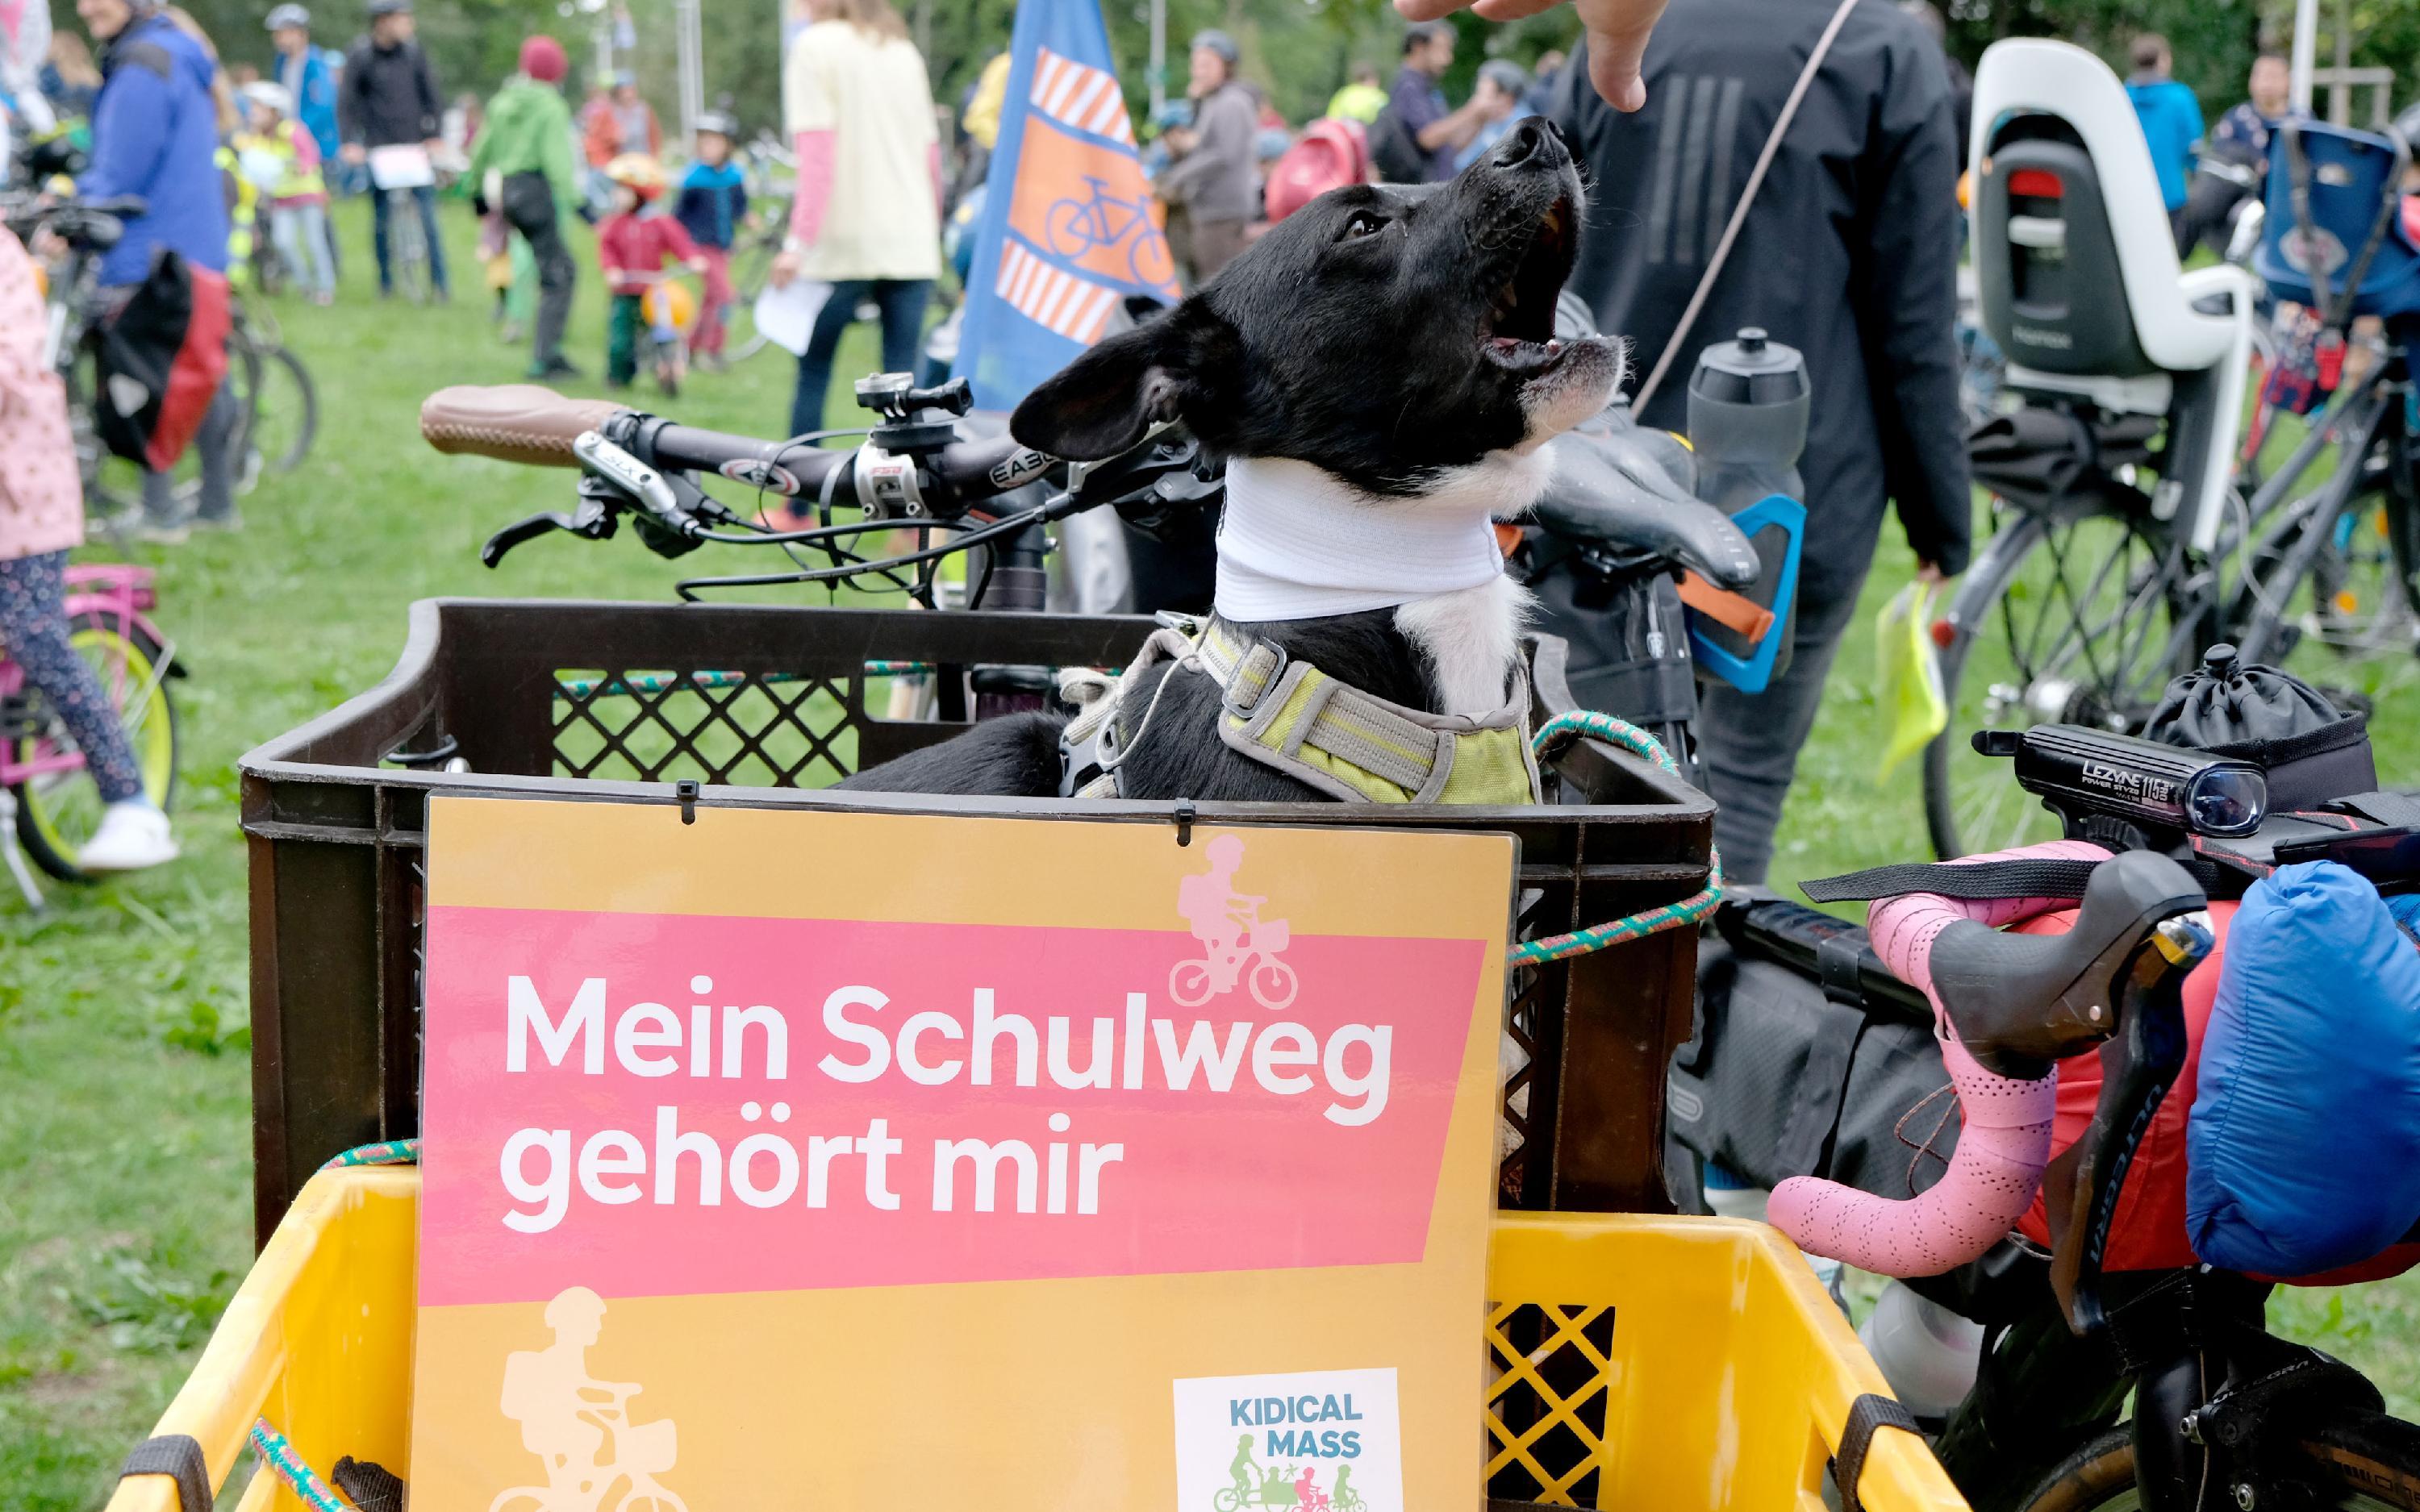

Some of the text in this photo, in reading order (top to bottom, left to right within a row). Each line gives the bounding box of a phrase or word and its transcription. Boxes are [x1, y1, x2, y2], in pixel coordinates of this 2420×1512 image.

[2082, 760, 2143, 788] LEZYNE
[2142, 776, 2161, 800] 115
[507, 975, 1392, 1127] Mein Schulweg
[500, 1101, 1124, 1234] gehört mir
[2089, 1084, 2163, 1264] ULTEGRA
[1230, 1393, 1363, 1427] KIDICAL
[1266, 1430, 1362, 1459] MASS
